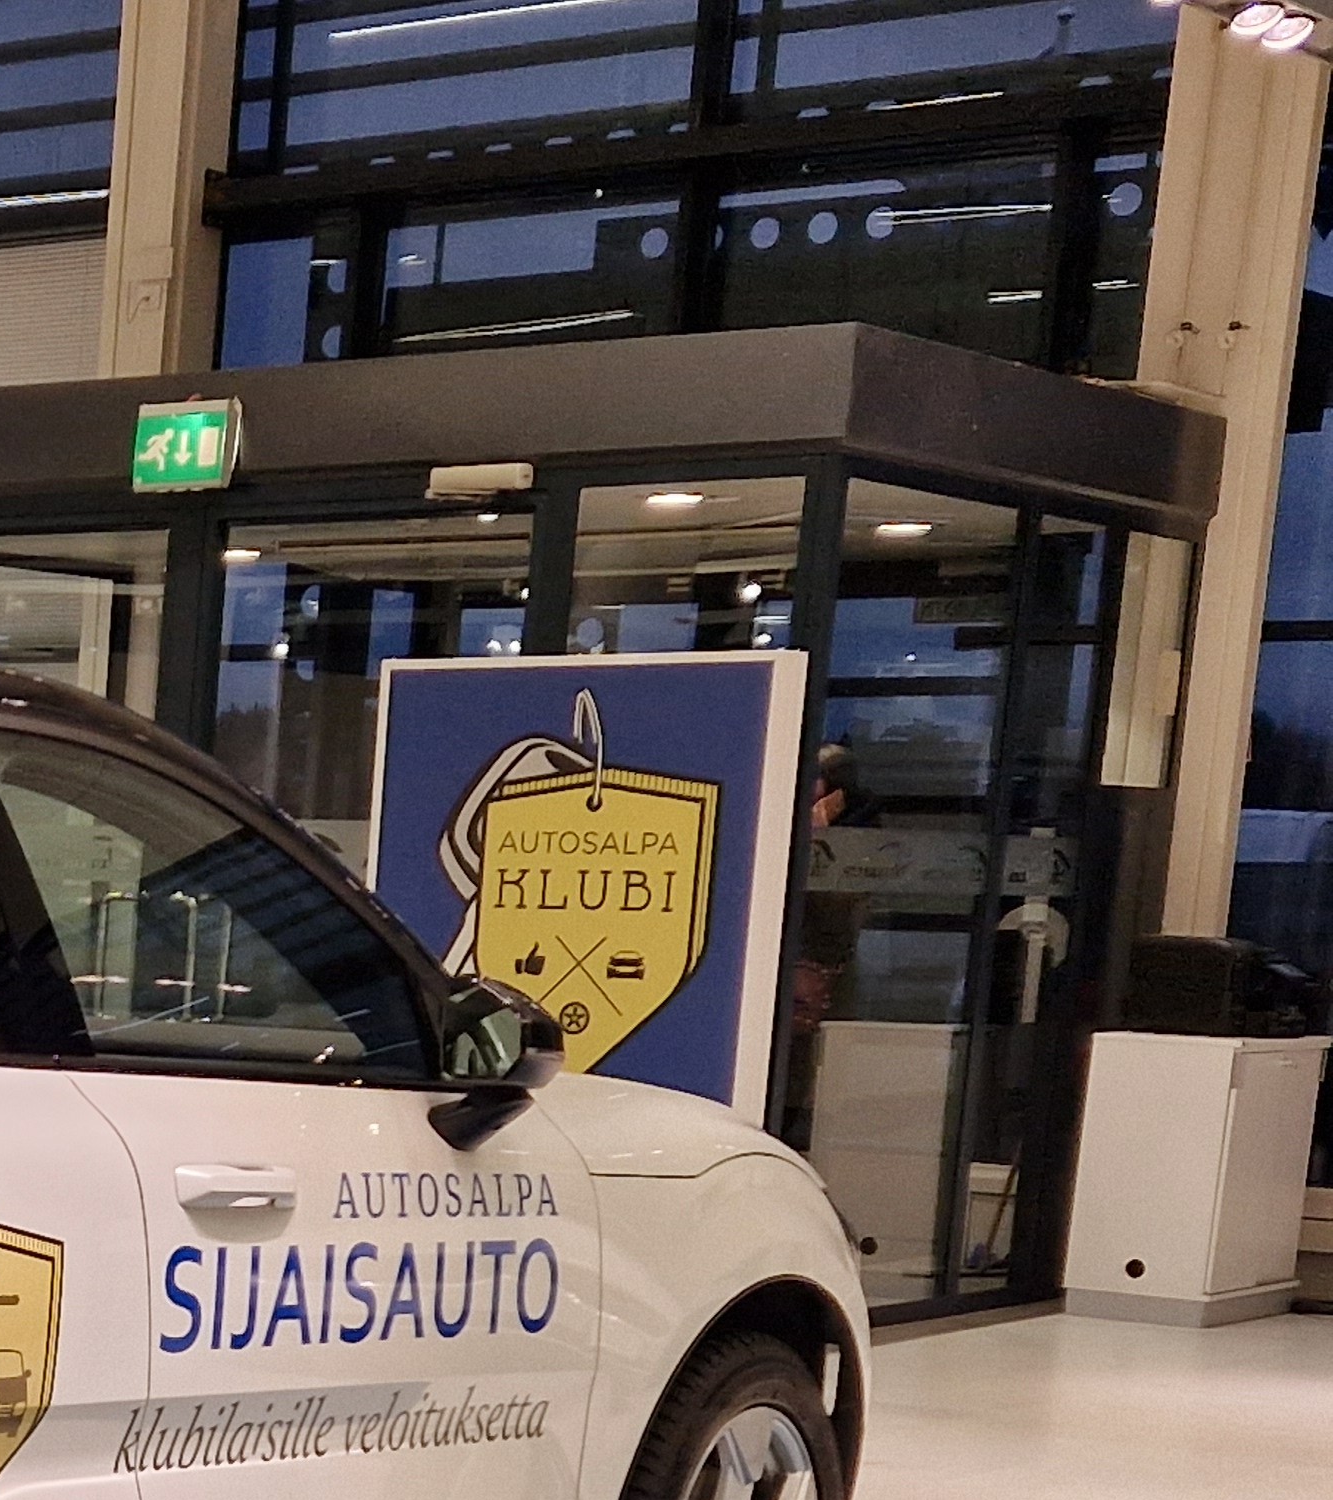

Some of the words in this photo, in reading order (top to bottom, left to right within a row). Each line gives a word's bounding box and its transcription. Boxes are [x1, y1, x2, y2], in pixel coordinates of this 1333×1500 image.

[497, 830, 680, 855] AUTOSALPA
[493, 868, 677, 913] KLUBI
[333, 1171, 560, 1219] AUTOSALPA
[158, 1237, 560, 1354] SIJAISAUTO
[112, 1395, 334, 1474] klubilaisille
[343, 1385, 550, 1453] veloituksetta
